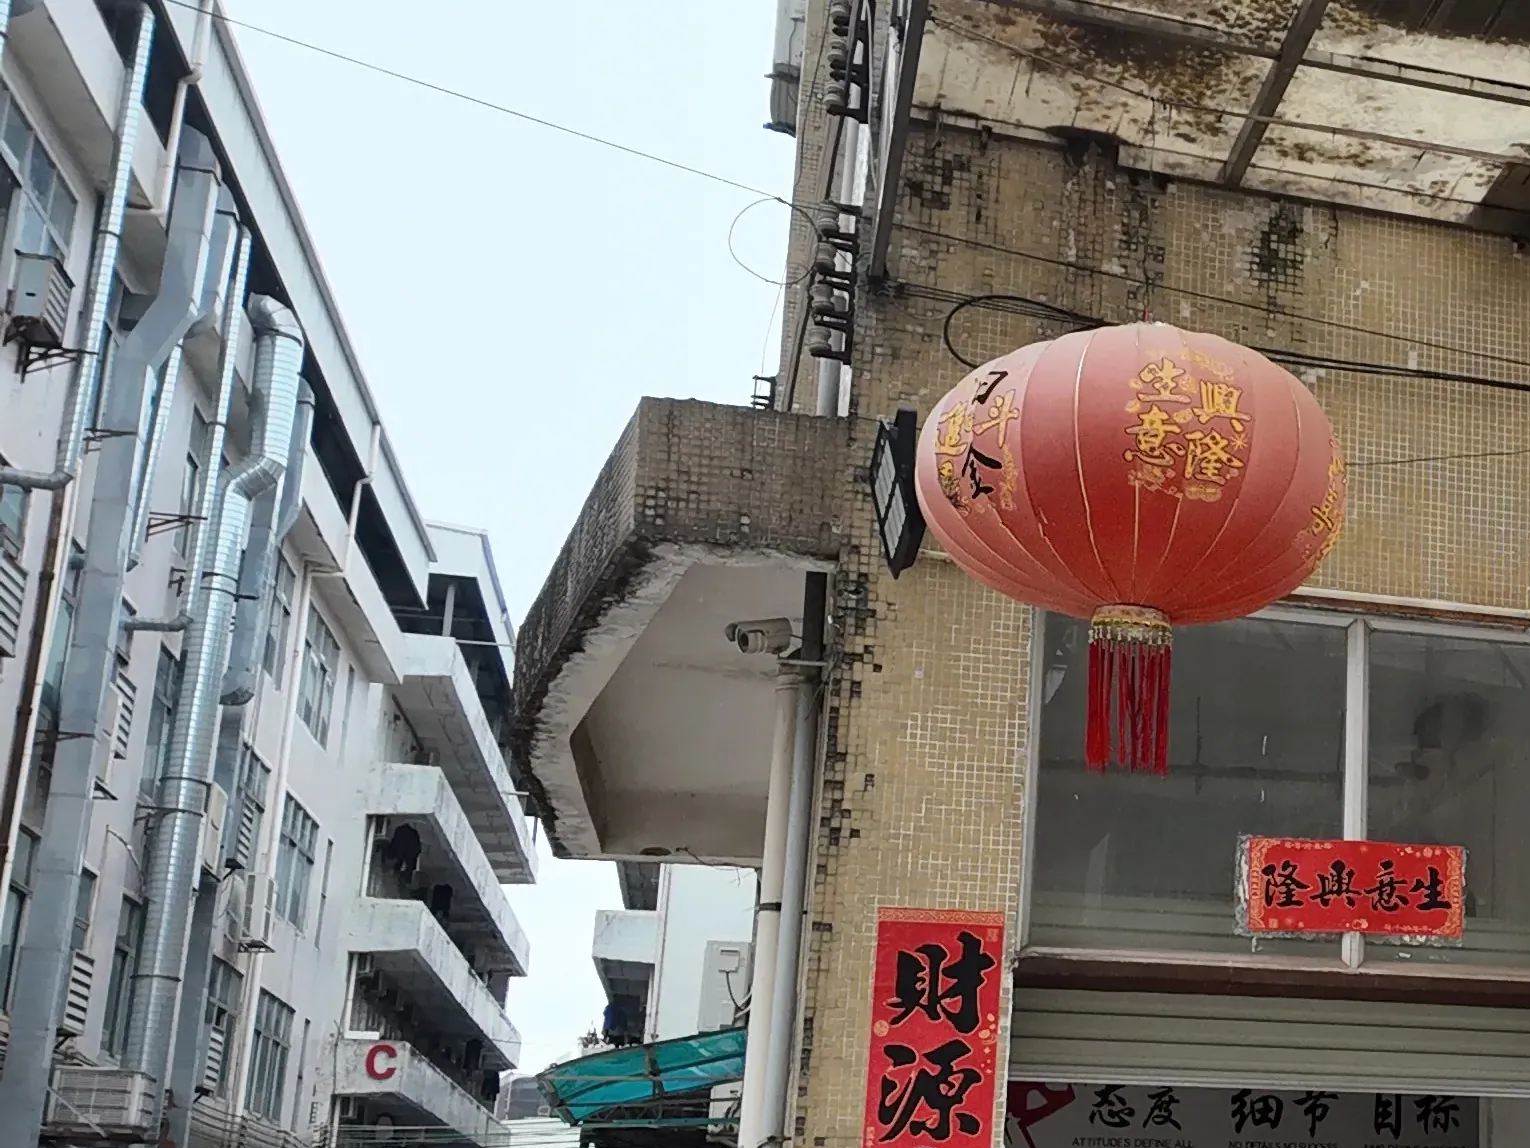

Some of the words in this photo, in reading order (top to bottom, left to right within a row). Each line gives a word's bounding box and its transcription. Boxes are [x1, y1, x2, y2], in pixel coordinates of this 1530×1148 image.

[366, 1044, 397, 1080] C
[1089, 1084, 1182, 1131] 态度
[1230, 1089, 1339, 1138] 细节
[1072, 1136, 1132, 1148] ATTITUDES
[1174, 1139, 1194, 1148] ALL
